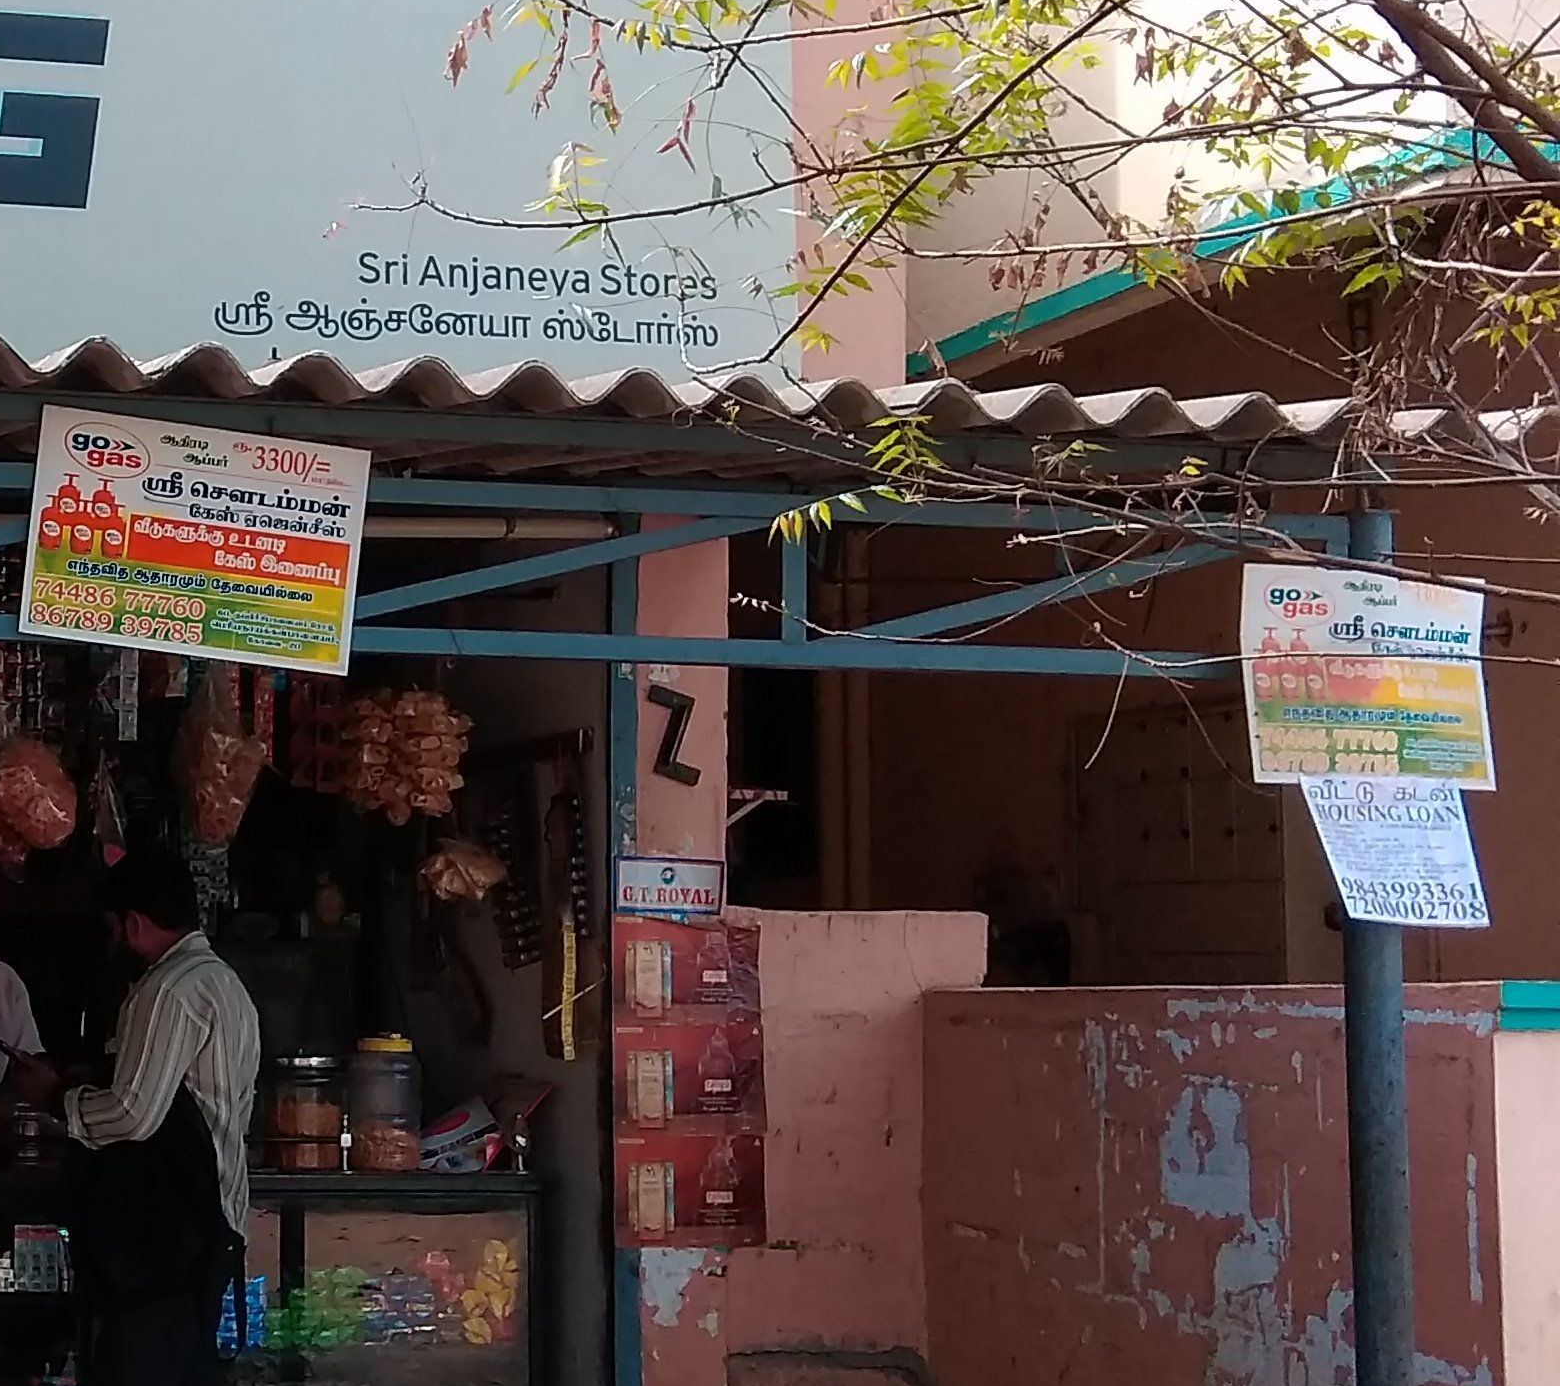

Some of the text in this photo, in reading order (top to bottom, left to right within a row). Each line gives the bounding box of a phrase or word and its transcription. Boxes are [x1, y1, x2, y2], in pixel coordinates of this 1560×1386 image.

[358, 252, 718, 300] Sri Anjaneya Stores
[72, 431, 111, 453] go
[87, 449, 142, 469] gas
[66, 559, 129, 579] எந்தவித
[134, 568, 206, 590] ஆதாரமும்
[33, 578, 116, 607] 74486
[123, 590, 205, 619] 77760
[1269, 587, 1301, 606] go
[1282, 601, 1329, 619] gas
[31, 602, 113, 631] 86789
[120, 615, 203, 644] 39785
[1309, 779, 1455, 804] வீட்டு கடன்
[1315, 804, 1460, 823] HOUSING LOAN
[1341, 877, 1479, 900] 9843993361
